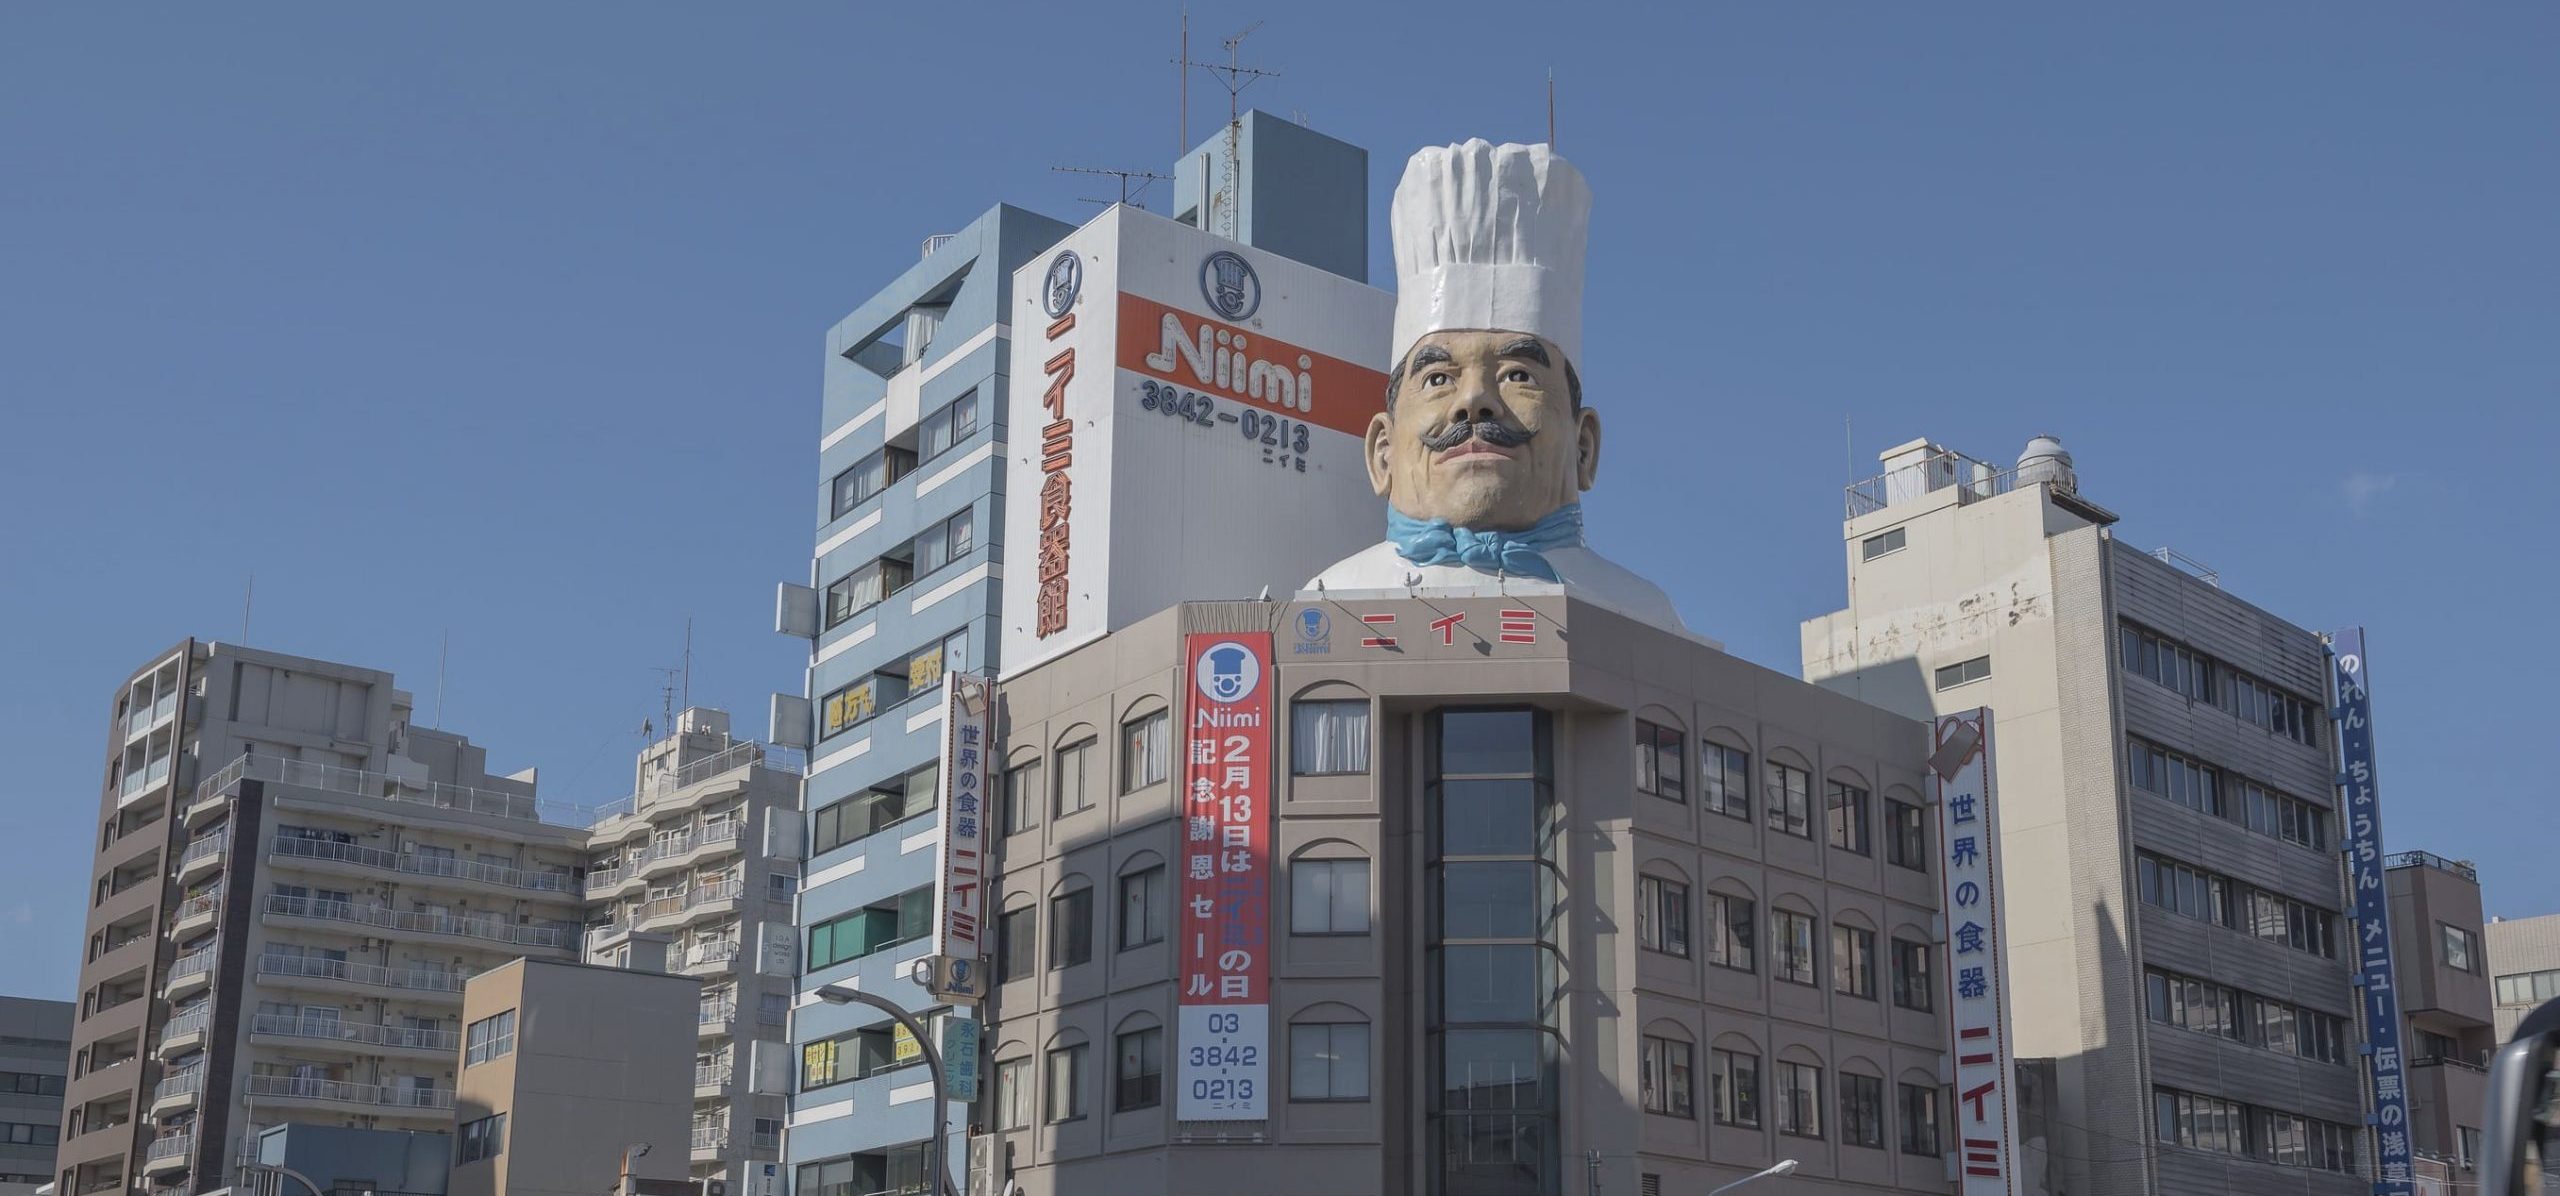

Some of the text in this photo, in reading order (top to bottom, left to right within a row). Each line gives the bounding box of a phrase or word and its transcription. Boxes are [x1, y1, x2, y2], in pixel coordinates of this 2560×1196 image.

[1146, 312, 1312, 413] Niimi
[1141, 379, 1310, 454] 3842-0213
[1037, 312, 1075, 640] ニイミ食器館
[1262, 447, 1306, 473] ニイミ
[1360, 608, 1537, 648] ニイミ
[1192, 706, 1261, 729] Niimi
[952, 724, 980, 942] 世界の食器 ニイミ
[1186, 739, 1216, 997] 記念謝恩セール
[2339, 653, 2411, 1196] のれん・ちょうちん・メニュー・伝票の浅草
[1950, 792, 2001, 1178] 世界の食器 ニイミ
[1208, 1013, 1239, 1034] 03
[1189, 1045, 1258, 1067] 3842
[1192, 1078, 1254, 1101] 0213
[1212, 1102, 1251, 1110] ニイミ
